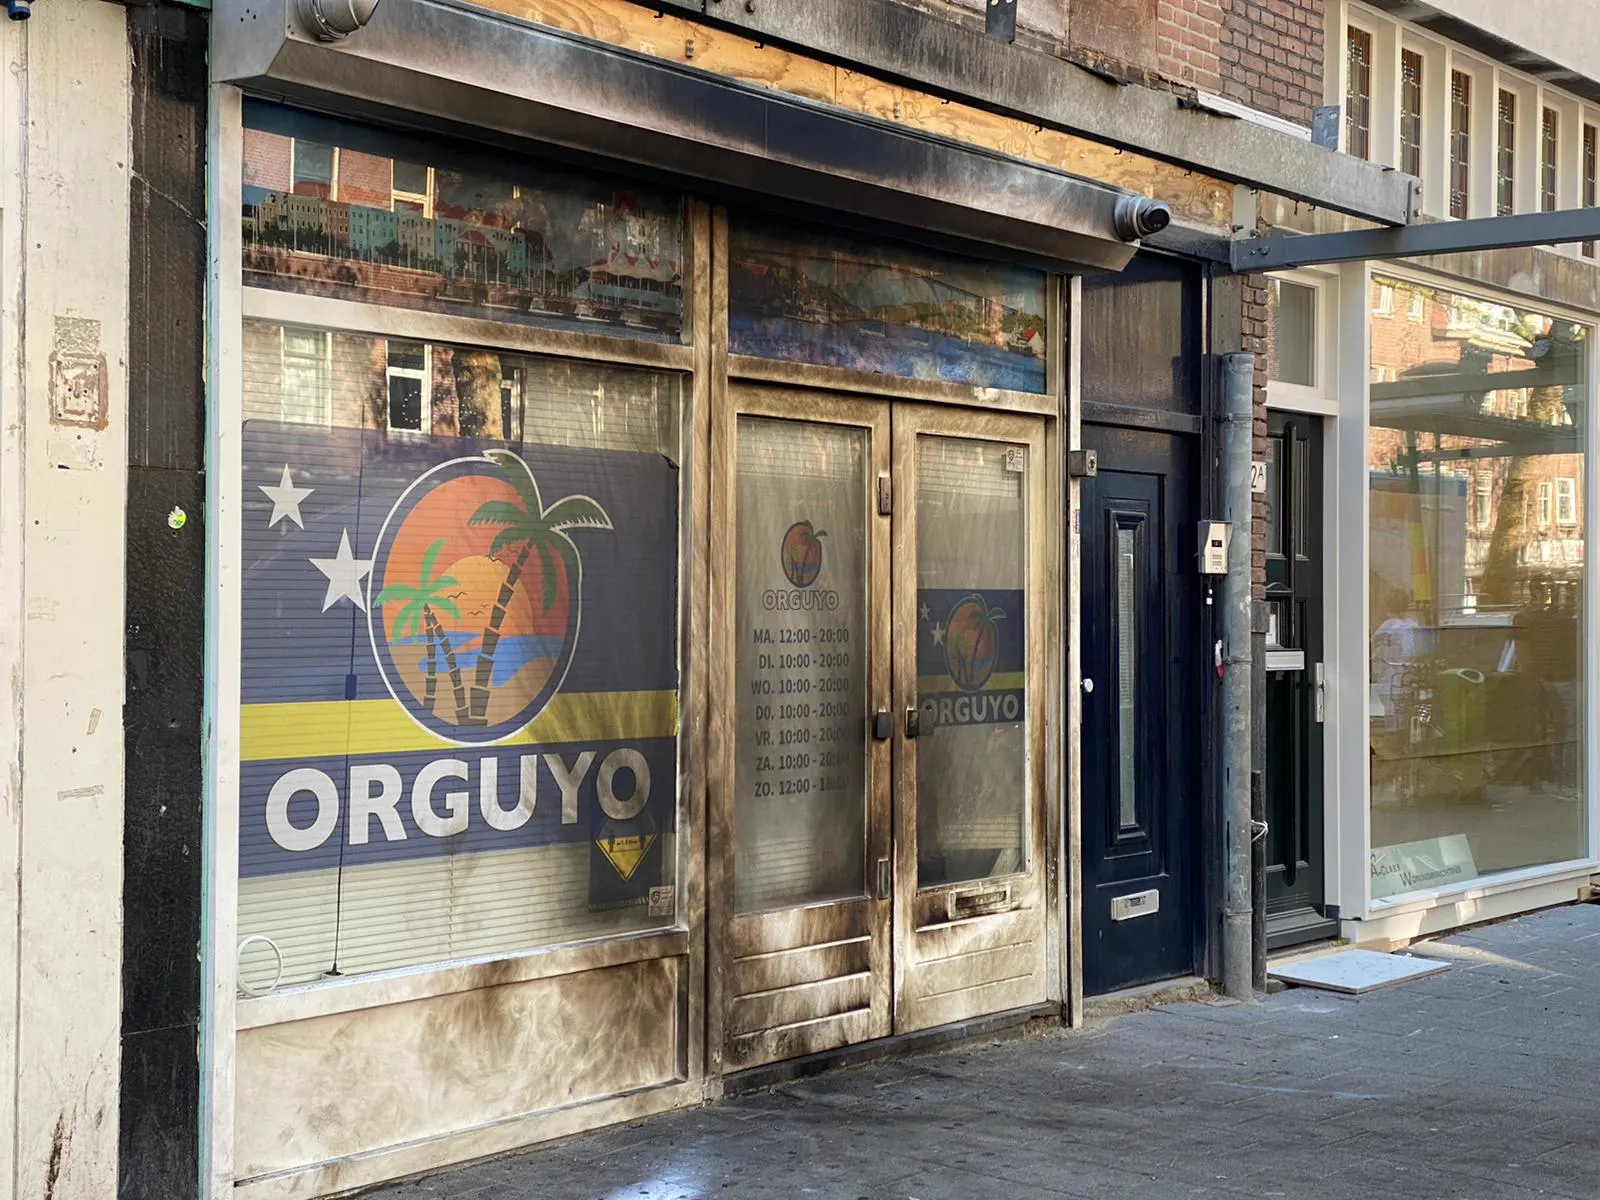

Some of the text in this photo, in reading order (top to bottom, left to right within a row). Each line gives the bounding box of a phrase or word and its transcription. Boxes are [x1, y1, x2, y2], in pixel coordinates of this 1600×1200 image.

[762, 589, 839, 611] ORGUYO
[753, 629, 775, 644] MA.
[779, 628, 810, 643] 12:00
[819, 627, 849, 642] 20:00
[759, 654, 775, 669] DI.
[779, 654, 810, 668] 10:00
[819, 653, 849, 668] 20:00
[751, 680, 775, 695] WO.
[779, 679, 810, 694] 10:00
[819, 678, 849, 693] 20:00
[756, 705, 775, 721] DO.
[779, 704, 810, 719] 10:00
[819, 702, 849, 718] 20:00
[921, 694, 1020, 723] ORGUYO
[755, 730, 775, 746] VR.
[779, 729, 810, 744] 10:00
[756, 755, 775, 771] ZA.
[779, 754, 810, 770] 10:00
[755, 780, 775, 797] ZO.
[779, 778, 810, 795] 12:00
[265, 748, 651, 852] ORGUYO
